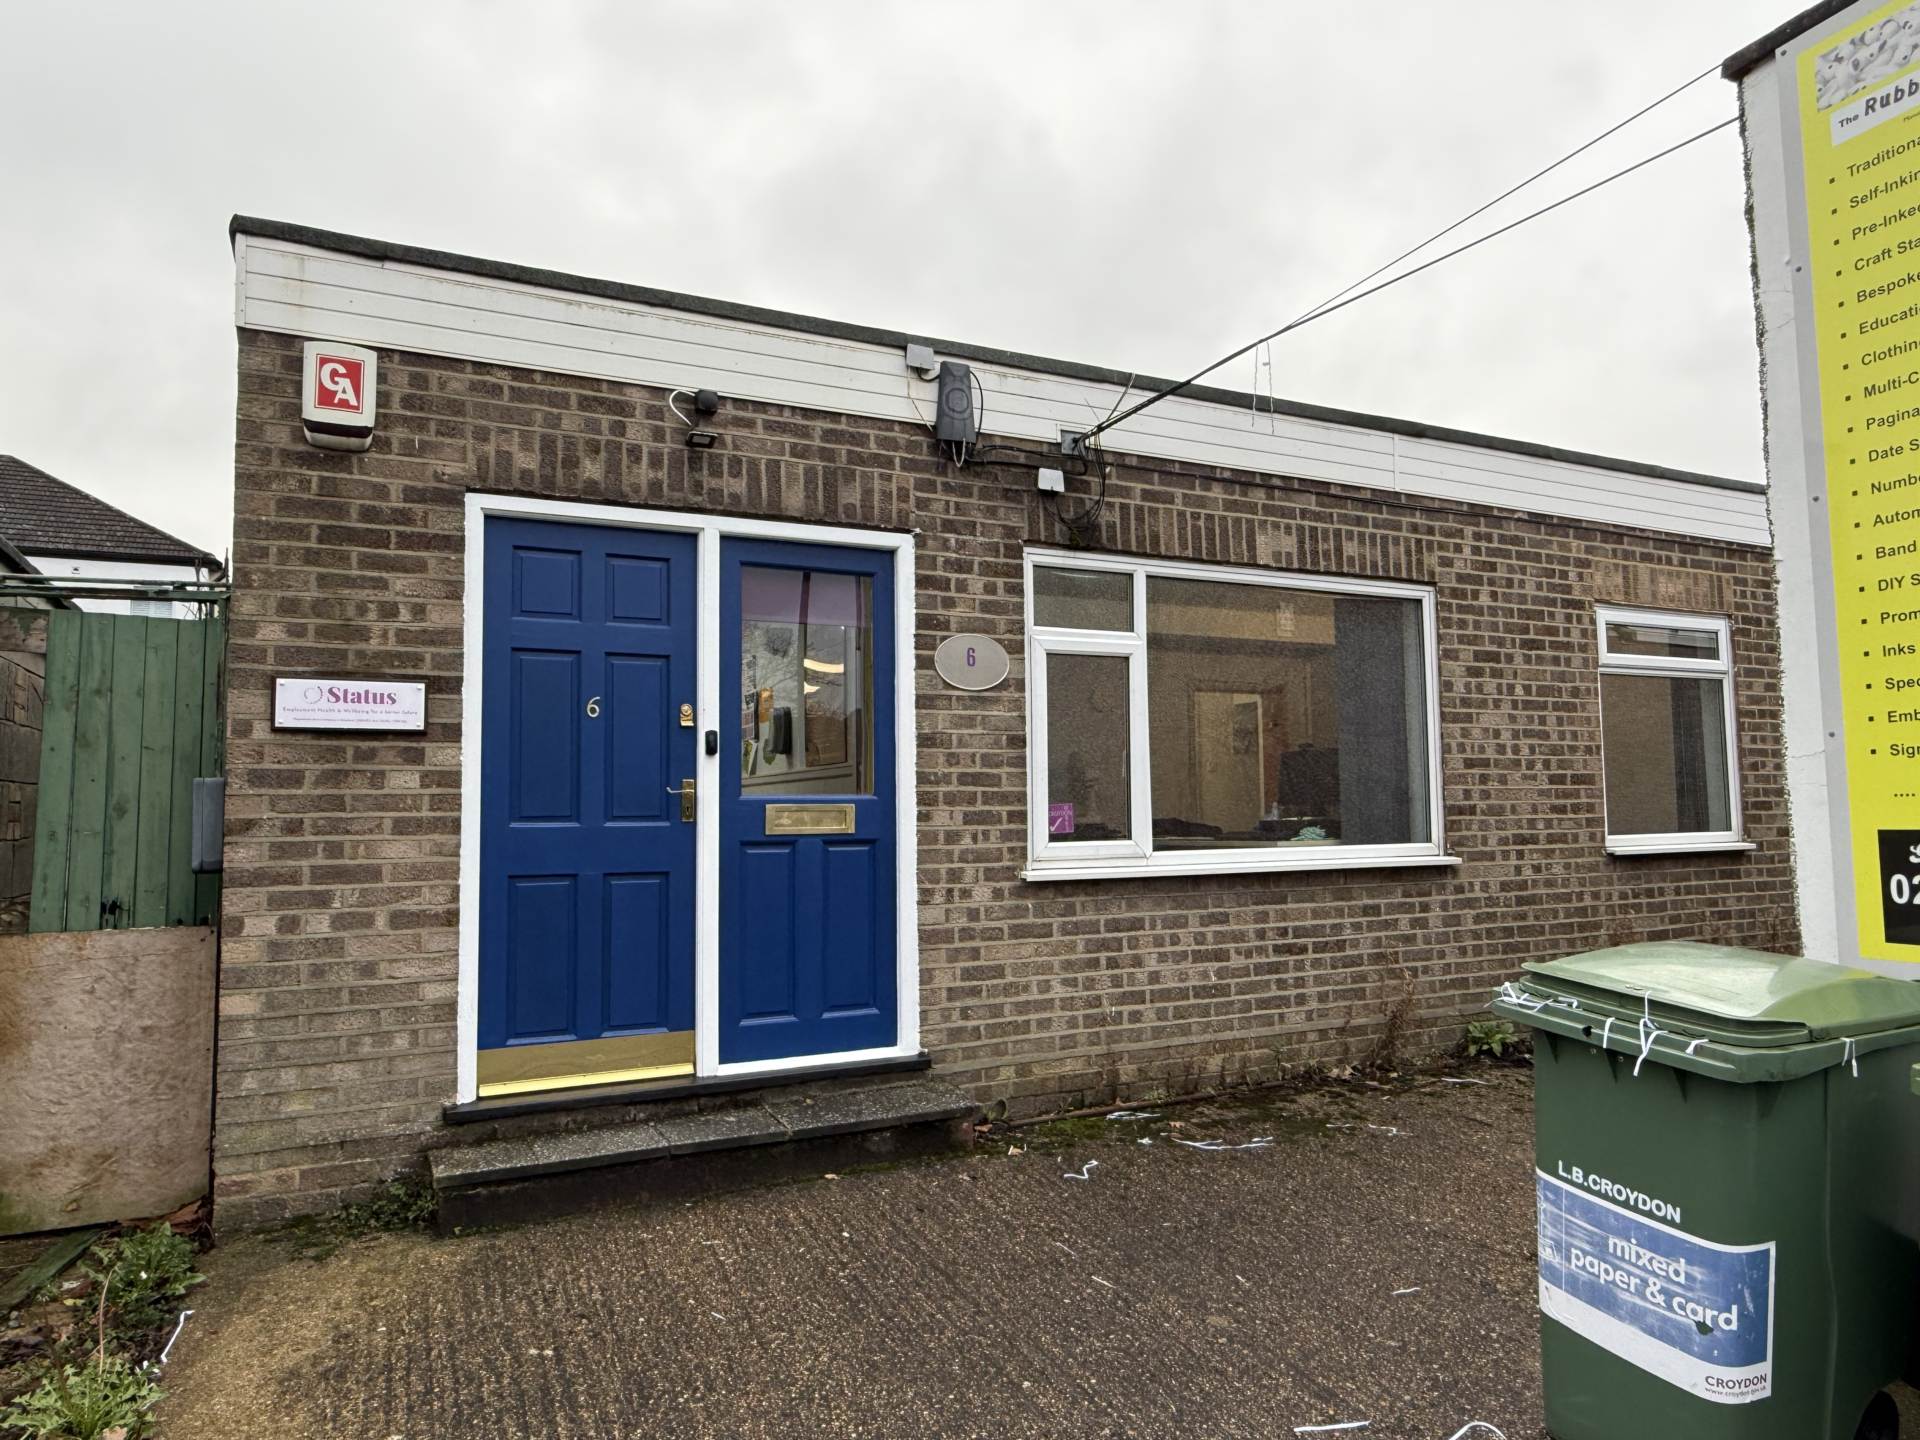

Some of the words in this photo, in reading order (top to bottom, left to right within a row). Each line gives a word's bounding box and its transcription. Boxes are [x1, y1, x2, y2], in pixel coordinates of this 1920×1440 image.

[1838, 114, 1859, 128] The
[1865, 78, 1920, 117] Rubb
[1854, 247, 1892, 271] Craft
[1859, 304, 1920, 335] Educati
[1861, 340, 1920, 366] Clothin
[320, 362, 358, 406] GA
[1864, 371, 1920, 398] Multi-C
[1866, 407, 1920, 430] Pagina
[1868, 445, 1904, 462] Date
[1871, 473, 1920, 495] Numb
[1876, 539, 1917, 559] Band
[1878, 576, 1905, 592] DIY
[966, 647, 976, 667] 6
[1882, 643, 1916, 657] Inks
[327, 686, 397, 705] Status
[586, 696, 601, 718] 6
[1558, 1160, 1681, 1224] L.B.CROYDON
[1608, 1235, 1685, 1285] mixed
[1570, 1247, 1641, 1293] paper
[1645, 1277, 1668, 1308] &
[1672, 1295, 1738, 1331] card
[1705, 1373, 1767, 1390] CROYDON
